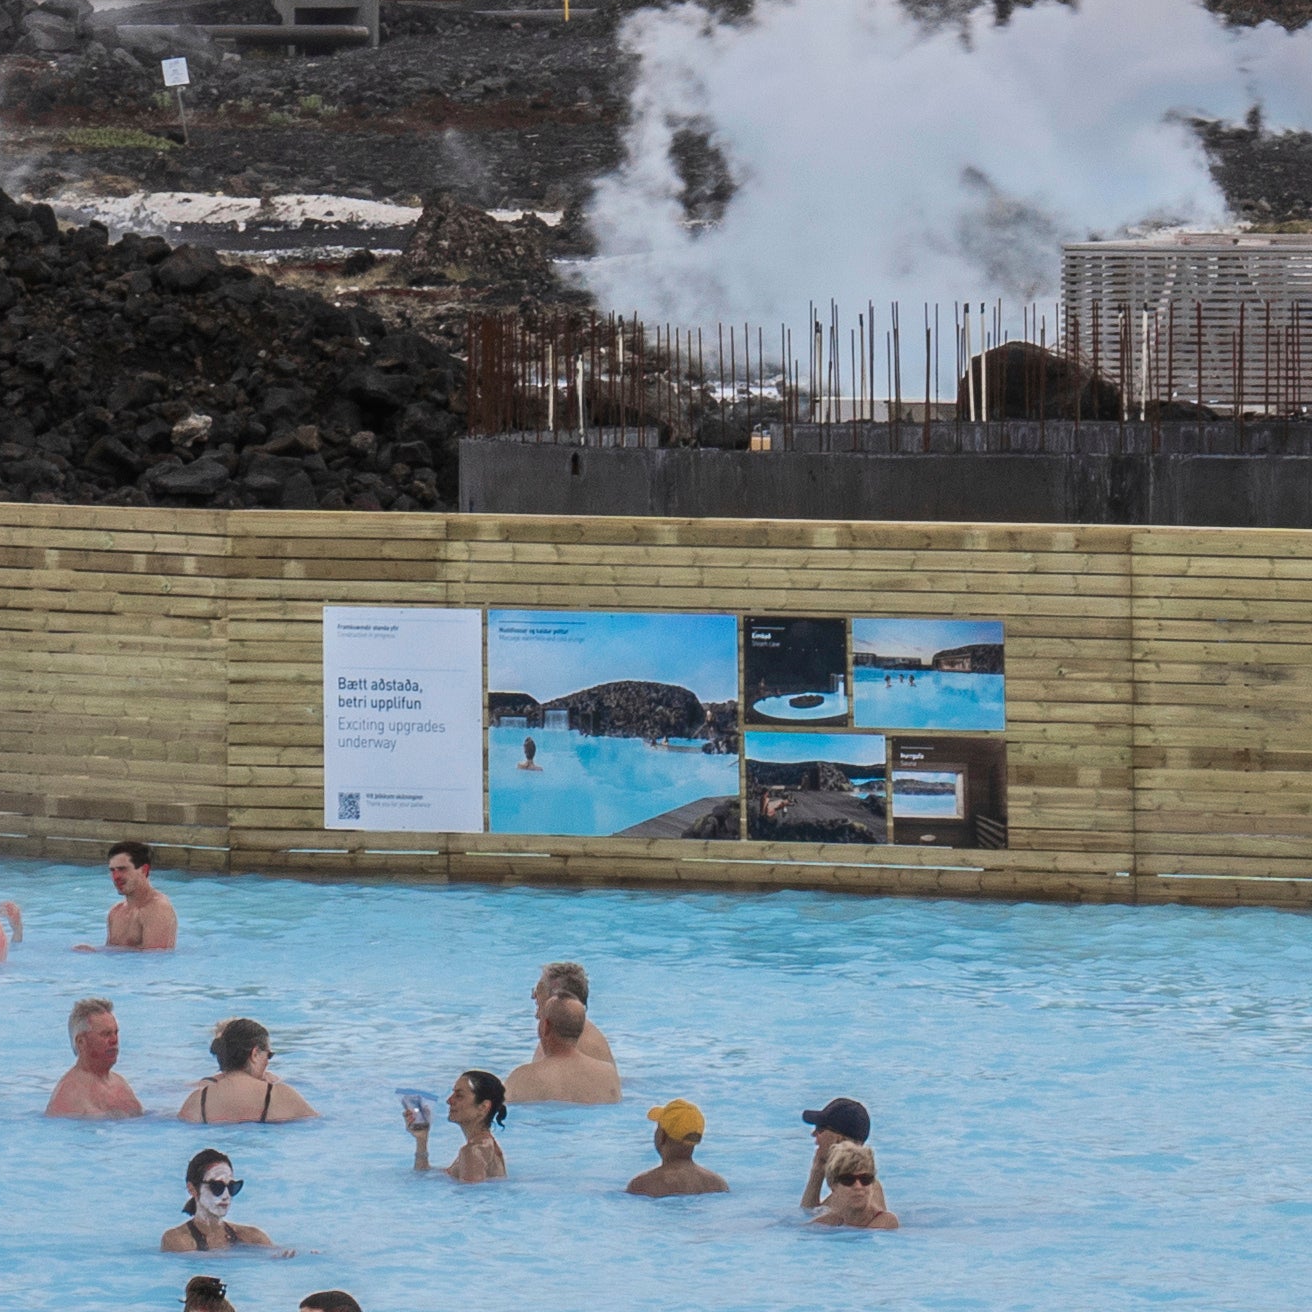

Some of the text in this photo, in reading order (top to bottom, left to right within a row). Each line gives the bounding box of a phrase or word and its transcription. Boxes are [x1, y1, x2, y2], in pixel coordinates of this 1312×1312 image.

[337, 676, 423, 693] Bætt aðstaða,
[337, 695, 422, 712] betri upplifun
[337, 716, 446, 736] Exciting upgrades
[337, 735, 397, 753] underway
